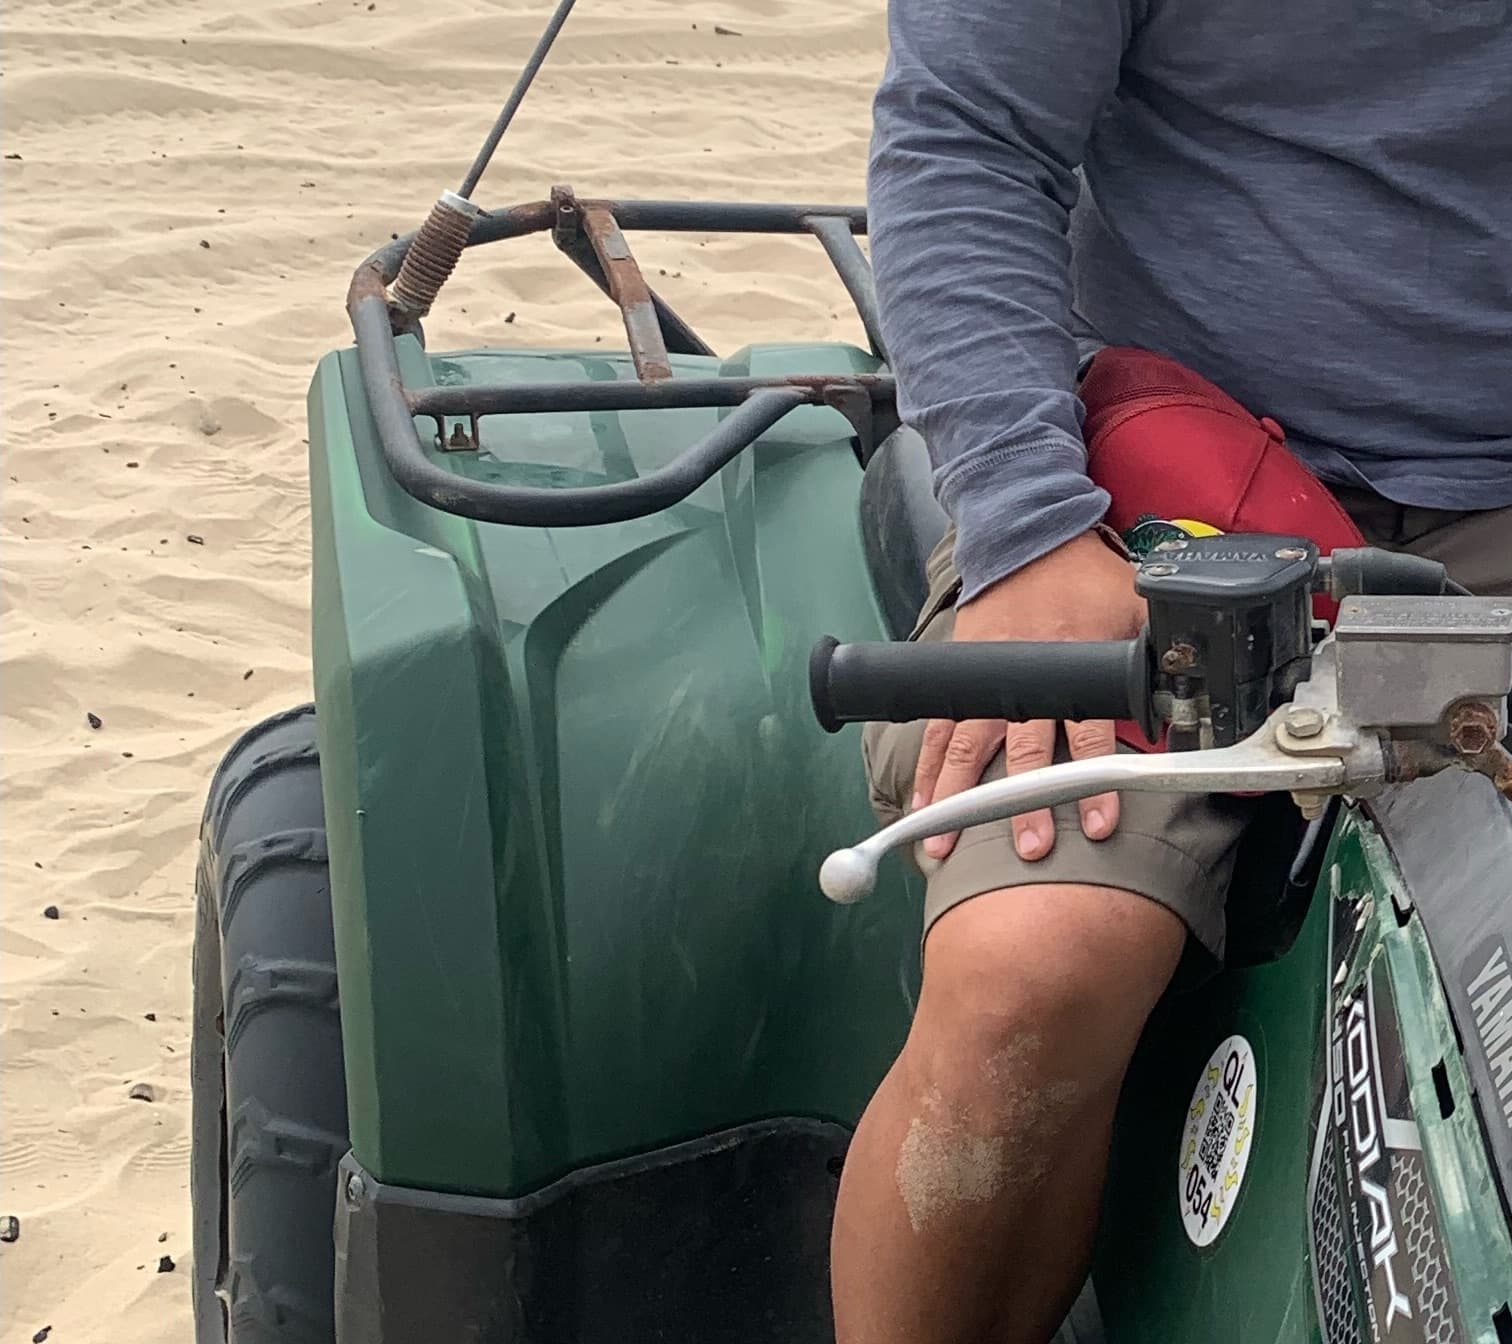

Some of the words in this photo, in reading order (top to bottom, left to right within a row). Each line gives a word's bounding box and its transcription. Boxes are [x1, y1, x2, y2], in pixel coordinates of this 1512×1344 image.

[1222, 1050, 1245, 1109] QL
[1186, 1163, 1213, 1229] 054
[1342, 1129, 1353, 1197] FUEL
[1350, 1201, 1381, 1343] INJECTION
